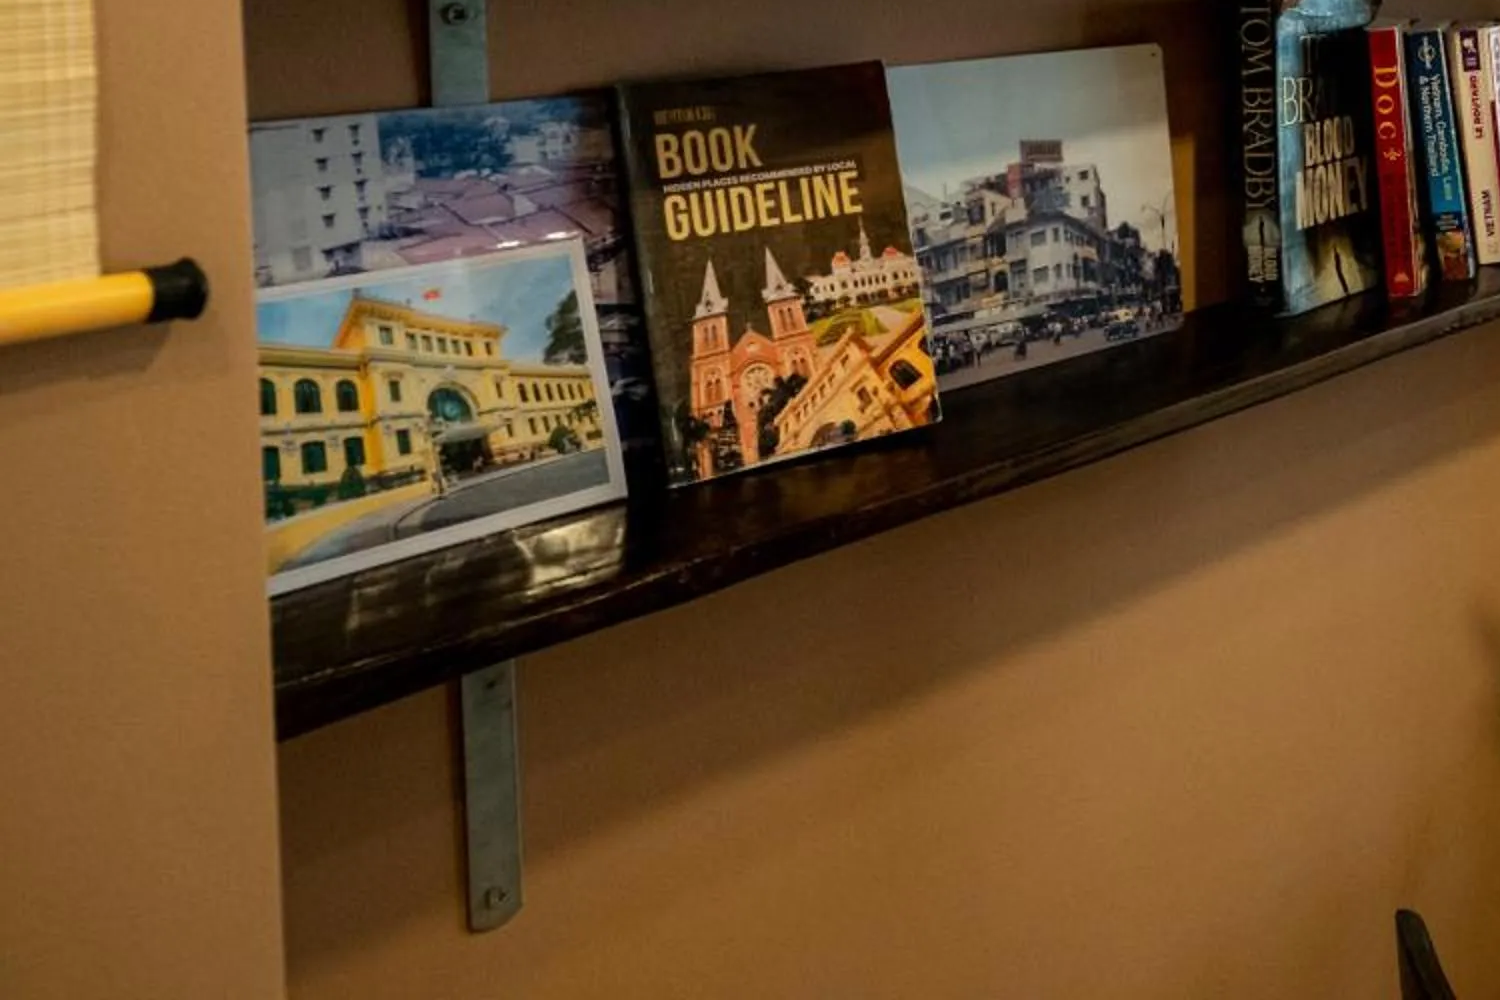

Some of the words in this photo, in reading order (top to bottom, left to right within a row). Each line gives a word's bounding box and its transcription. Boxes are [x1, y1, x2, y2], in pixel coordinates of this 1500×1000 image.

[1373, 64, 1399, 141] DOC
[655, 124, 764, 179] BOOK
[1243, 86, 1276, 209] BRADBY
[1304, 115, 1355, 165] BLOOD
[663, 180, 701, 193] HIDDEN
[701, 176, 738, 189] PLACES
[740, 167, 812, 184] RECOMMENDED
[813, 163, 825, 173] BY
[825, 159, 857, 171] LOCAL
[663, 171, 863, 241] GUIDELINE
[1296, 154, 1369, 230] MONEY
[1481, 189, 1494, 237] VIETNAM
